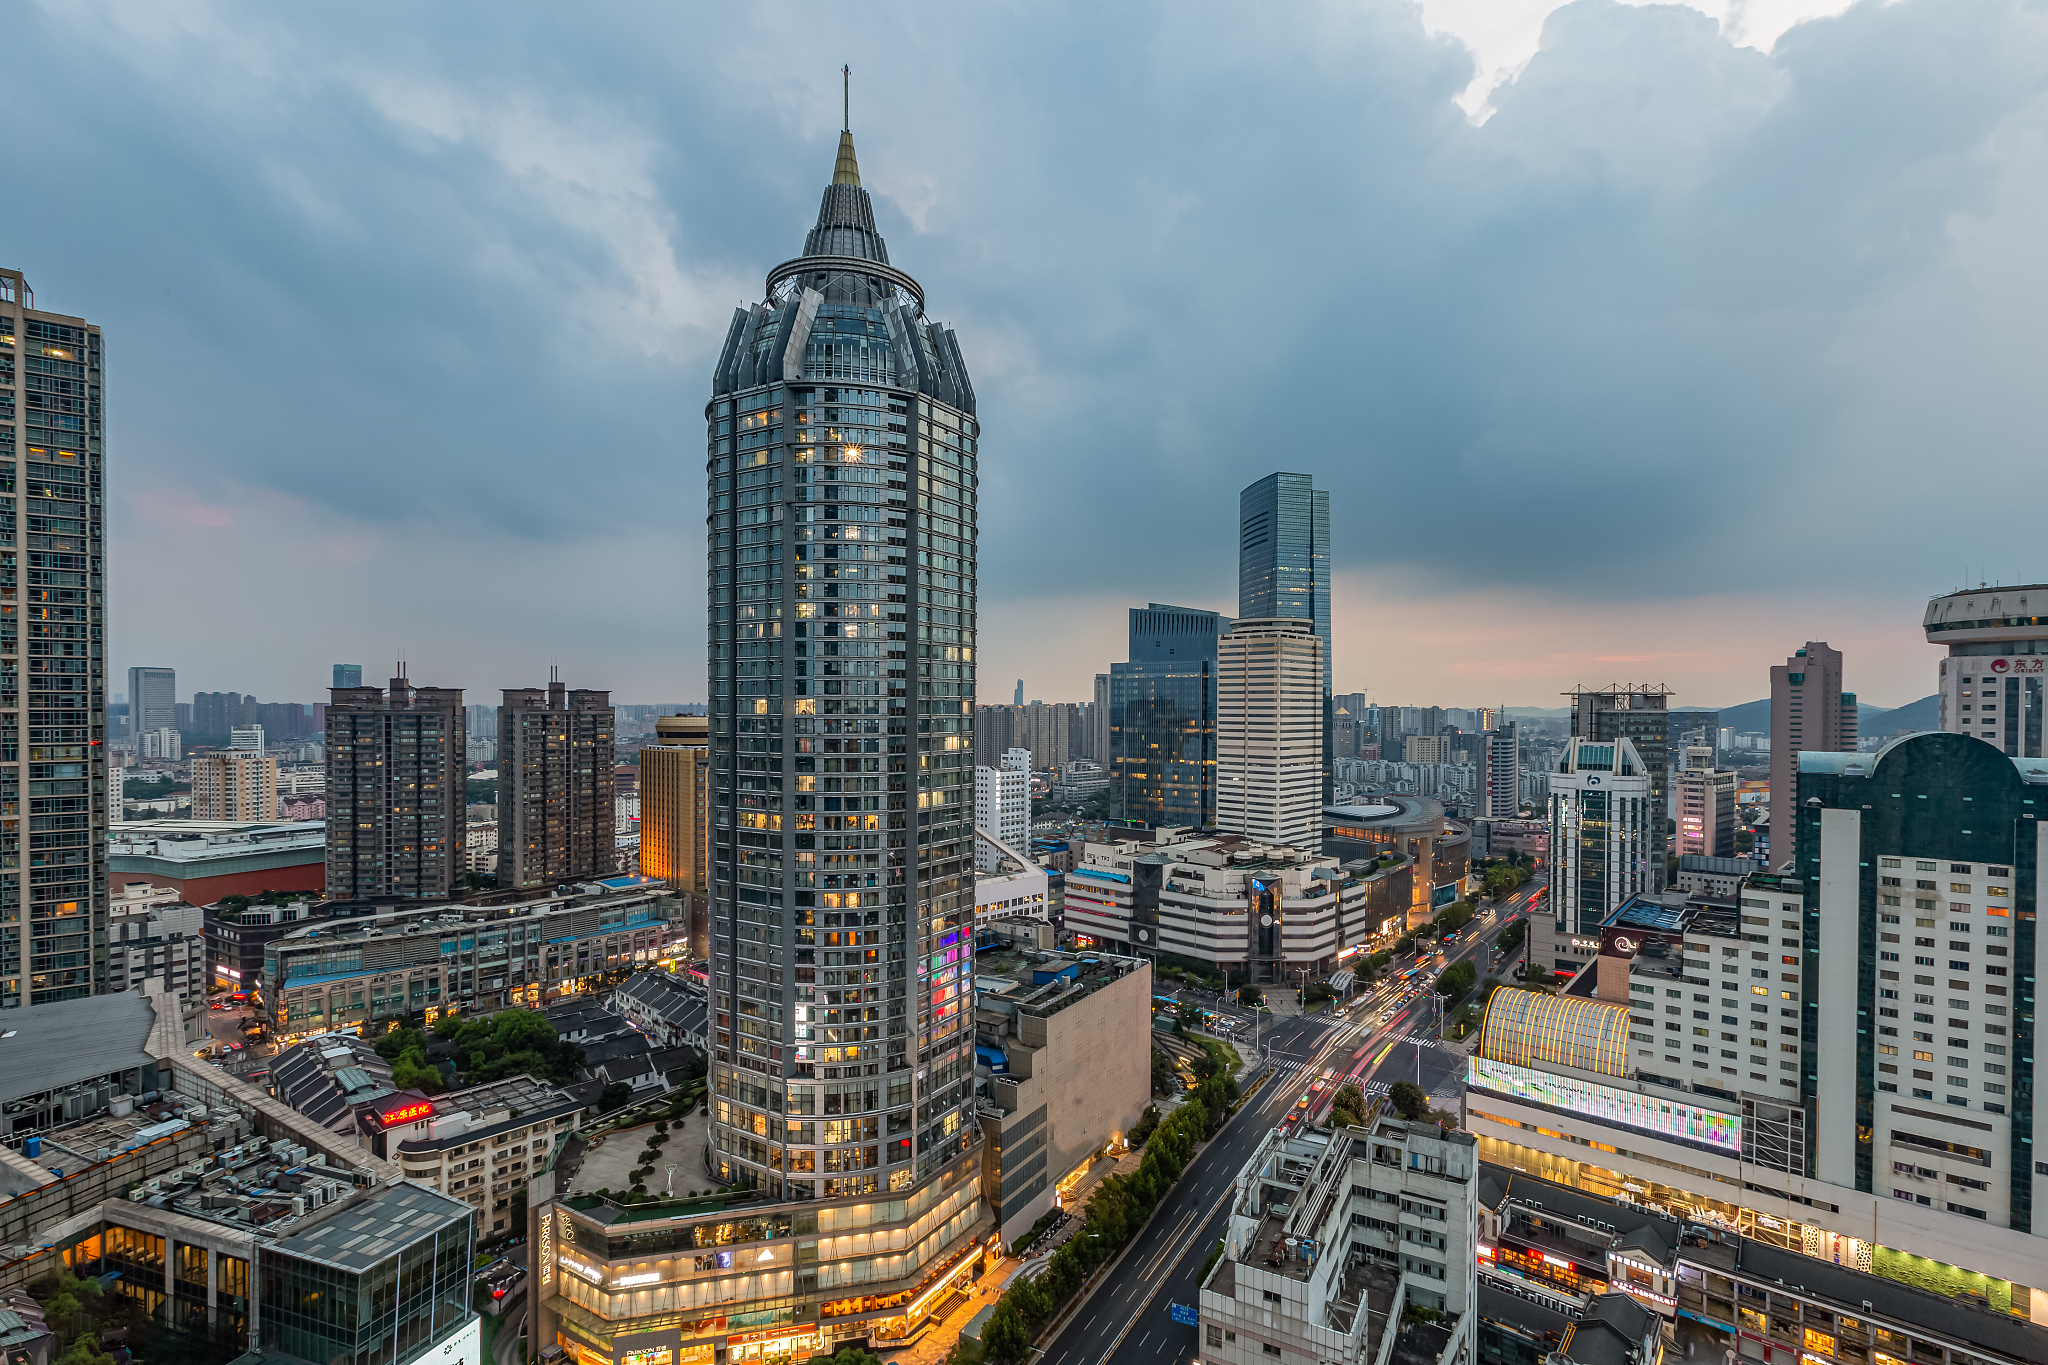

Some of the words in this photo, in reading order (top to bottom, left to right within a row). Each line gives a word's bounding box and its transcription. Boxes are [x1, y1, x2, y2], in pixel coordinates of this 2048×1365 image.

[2014, 658, 2045, 669] 东方
[385, 1104, 430, 1124] 江原医院
[541, 1213, 552, 1265] PARKSON
[626, 1347, 655, 1357] PARKSON
